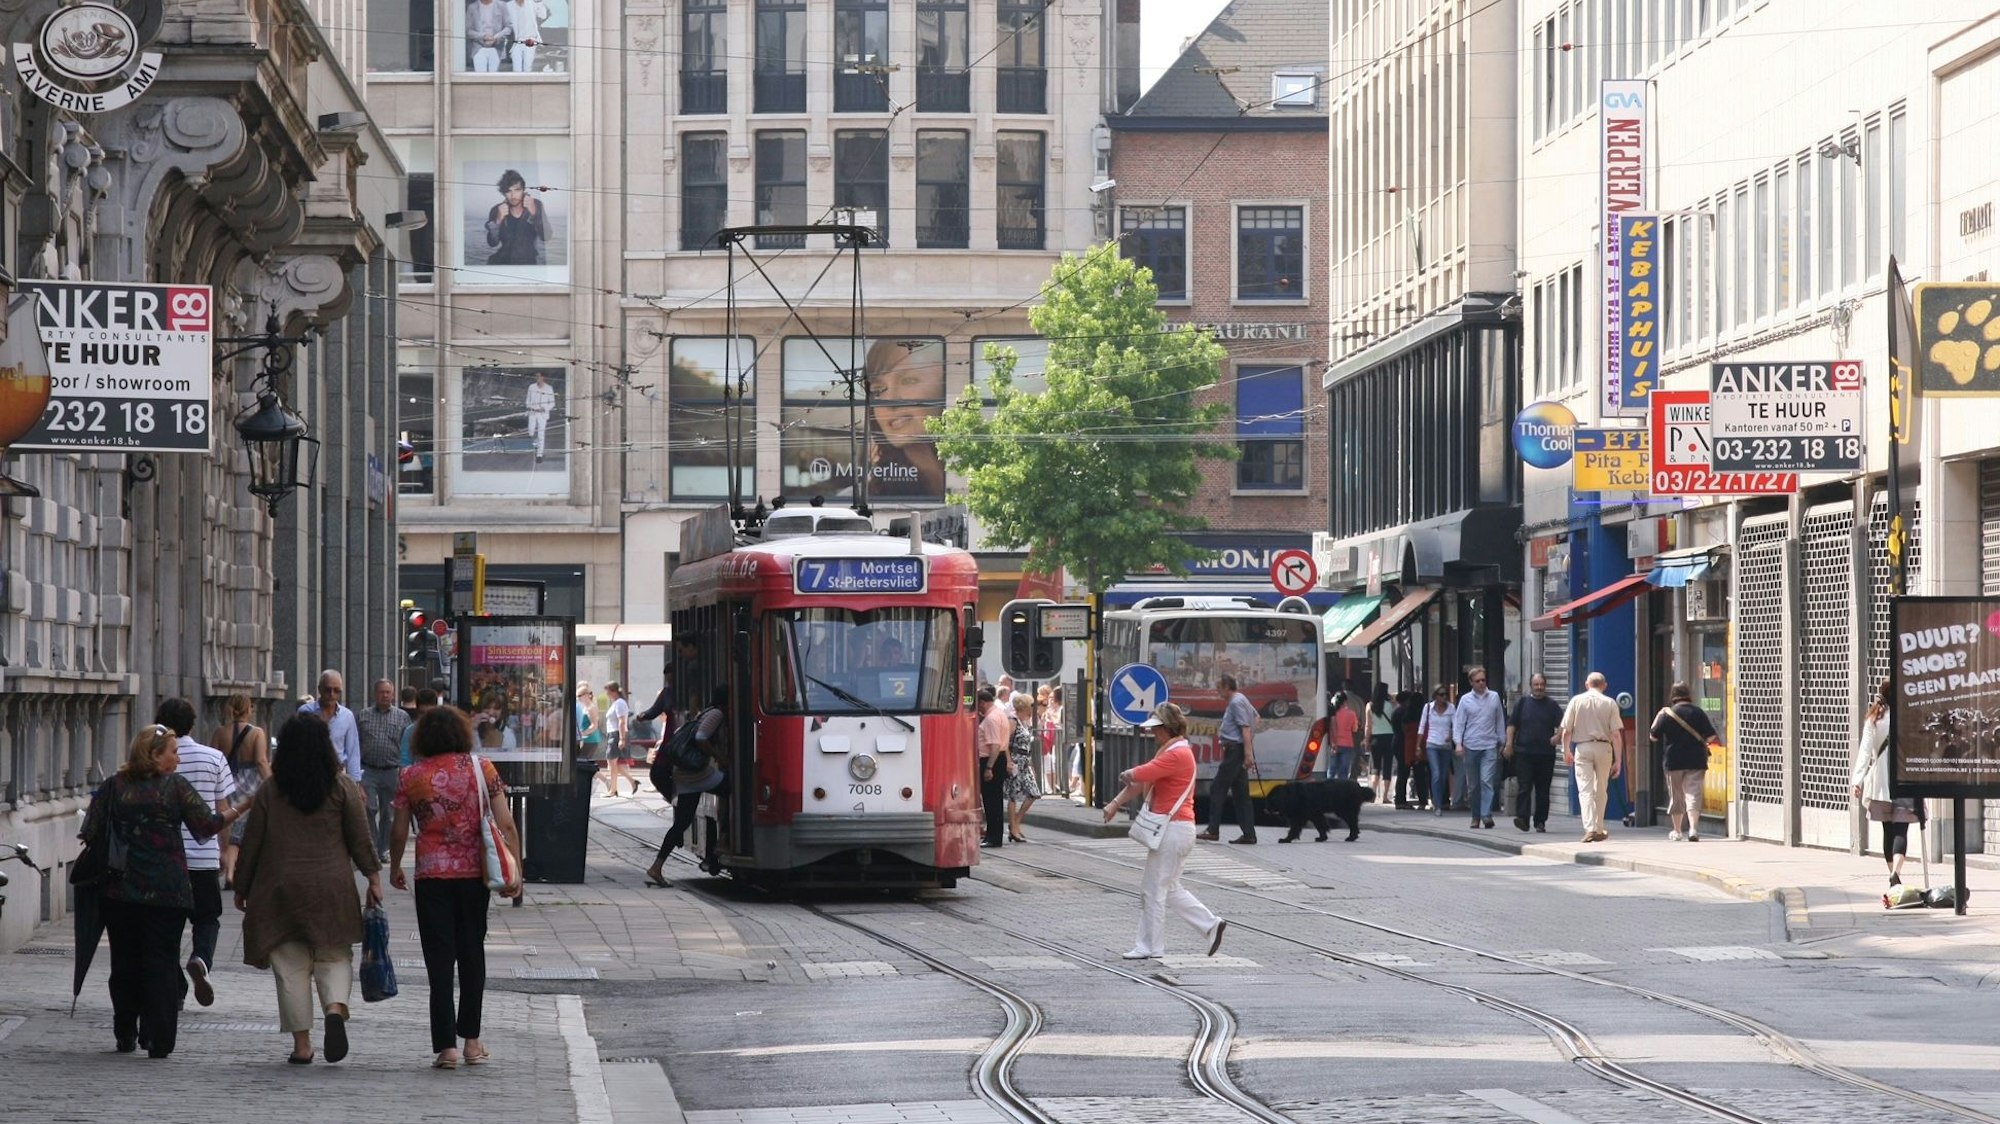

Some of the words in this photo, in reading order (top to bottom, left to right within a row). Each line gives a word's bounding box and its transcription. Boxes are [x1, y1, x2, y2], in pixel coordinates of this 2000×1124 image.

[16, 53, 106, 112] TAVERNE
[127, 62, 158, 99] AMI
[33, 287, 162, 332] NKER
[171, 292, 207, 332] 18
[1628, 220, 1654, 398] KEBAPHUIS
[88, 331, 206, 343] CONSULTANTS
[80, 342, 161, 367] HUUR
[51, 375, 80, 390] oor
[95, 373, 191, 392] showroom
[1715, 364, 1829, 393] ANKER
[1834, 363, 1860, 392] 18
[1716, 393, 1772, 401] PROPERTY
[1779, 392, 1860, 400] CONSULTANTS
[46, 400, 107, 433] 232
[119, 401, 156, 434] 18
[169, 402, 206, 435] 18
[1670, 406, 1710, 422] WINKE
[1748, 402, 1769, 419] TE
[1775, 401, 1827, 419] HUUR
[1724, 423, 1769, 434] Kantoren
[1771, 422, 1798, 432] vanaf
[1800, 421, 1813, 432] 50
[50, 435, 141, 447] www.anker18.be
[1603, 431, 1649, 450] EFE
[1715, 438, 1793, 461] 03-232
[1800, 438, 1825, 460] 18
[1834, 437, 1860, 459] 18
[1584, 452, 1622, 469] Pita
[1638, 452, 1649, 468] P
[1669, 454, 1677, 463] &
[808, 563, 826, 589] 7
[861, 561, 918, 574] Mortsel
[827, 575, 918, 589] St.-Pietersvliet
[1264, 629, 1288, 637] 4397
[1900, 622, 1981, 654] DUUR?
[549, 650, 560, 661] A
[1902, 650, 1968, 677] SNOB?
[893, 681, 906, 696] 2
[1903, 677, 1946, 697] GEEN
[848, 783, 883, 796] 7008
